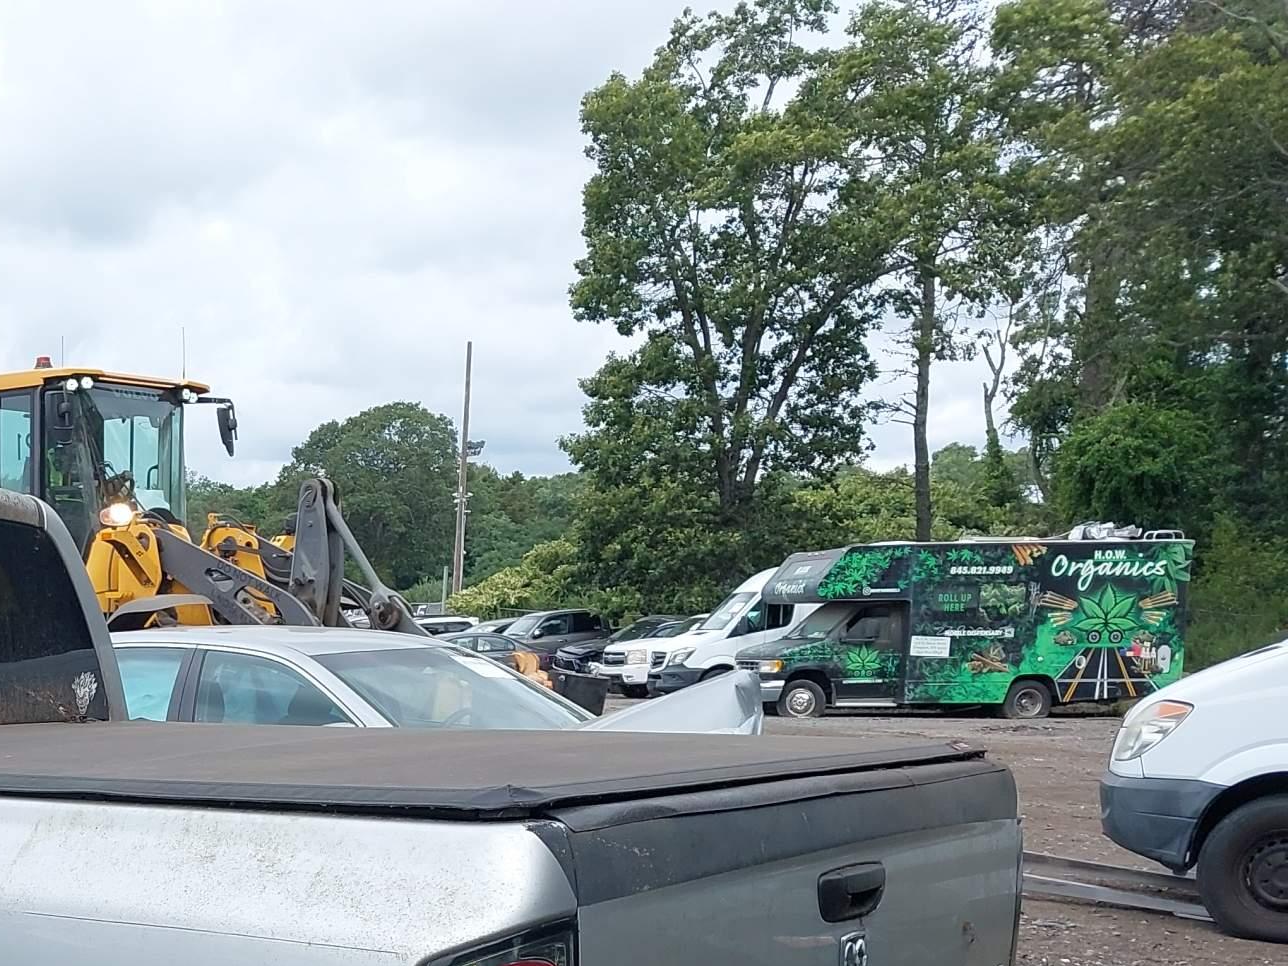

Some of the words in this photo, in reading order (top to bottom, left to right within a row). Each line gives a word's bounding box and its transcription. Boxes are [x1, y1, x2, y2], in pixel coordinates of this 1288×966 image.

[1094, 550, 1127, 560] H.O.W.
[1051, 552, 1168, 592] Organics
[938, 593, 959, 602] ROLL
[961, 593, 972, 602] UP
[944, 603, 965, 612] HERE
